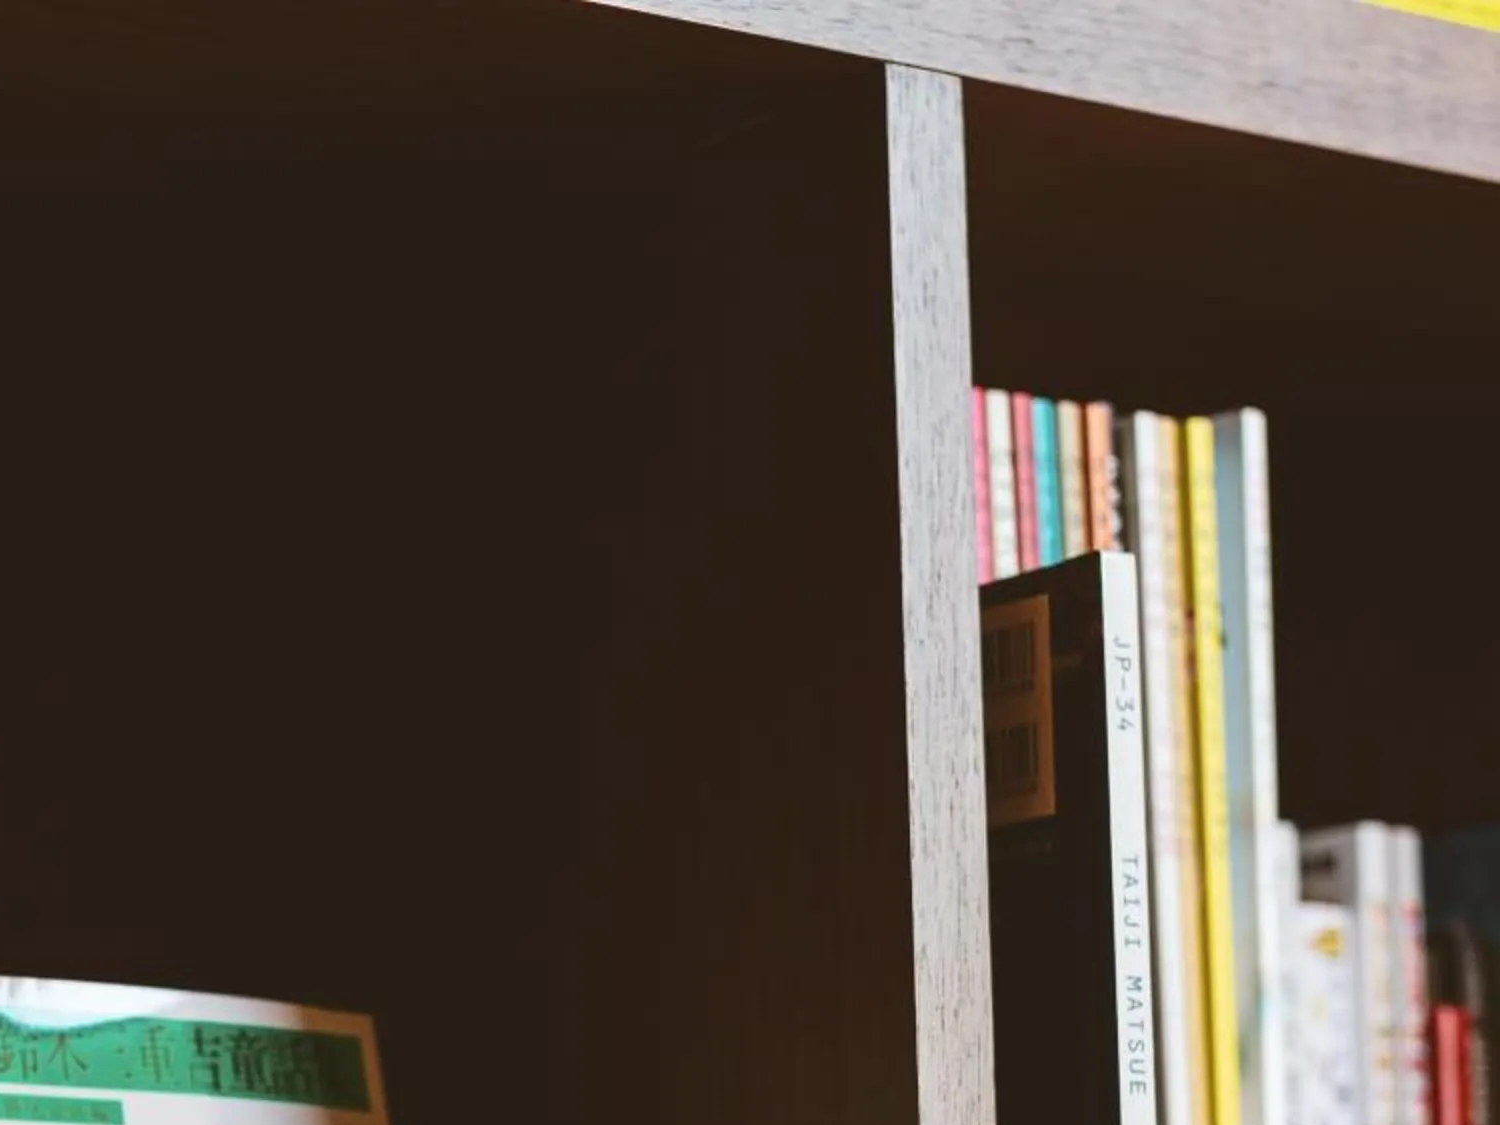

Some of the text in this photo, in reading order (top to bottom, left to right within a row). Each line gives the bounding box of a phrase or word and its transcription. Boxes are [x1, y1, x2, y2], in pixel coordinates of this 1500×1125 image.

[1114, 636, 1135, 732] JP-34
[1122, 853, 1148, 1096] TAIJI MATSUE
